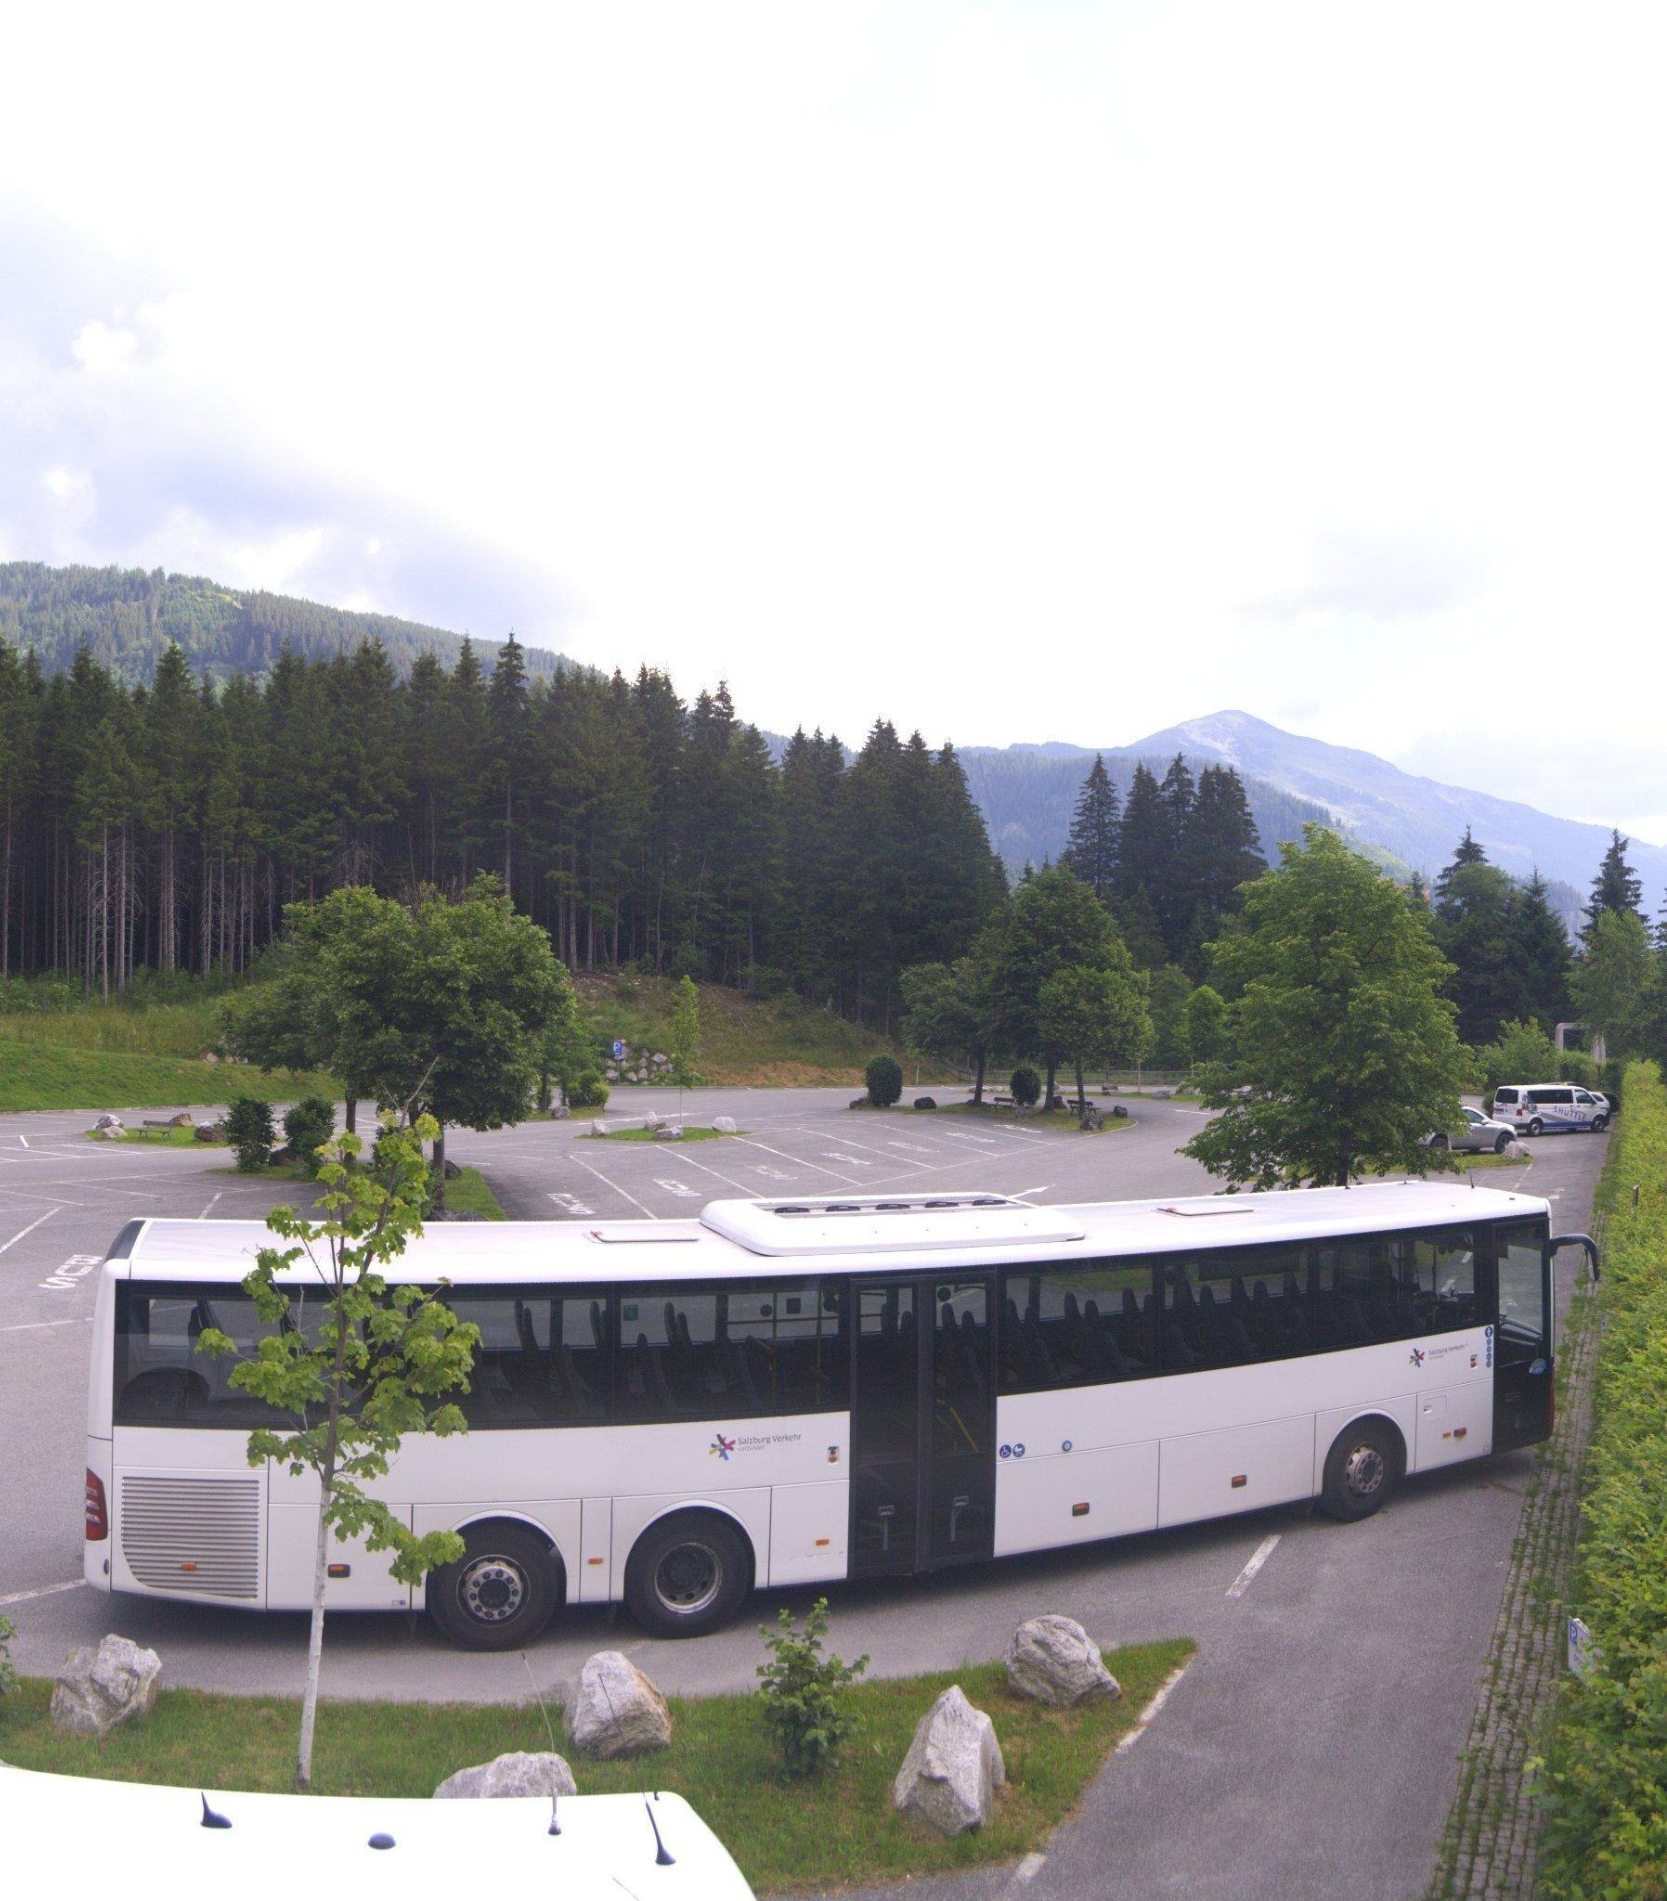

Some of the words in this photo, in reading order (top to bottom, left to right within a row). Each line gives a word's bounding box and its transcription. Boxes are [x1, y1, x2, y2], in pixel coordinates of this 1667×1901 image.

[1553, 1105, 1587, 1121] SHUTTLE
[38, 1254, 103, 1289] BUS
[738, 1436, 771, 1445] Salzburg
[772, 1433, 802, 1443] Verkehr
